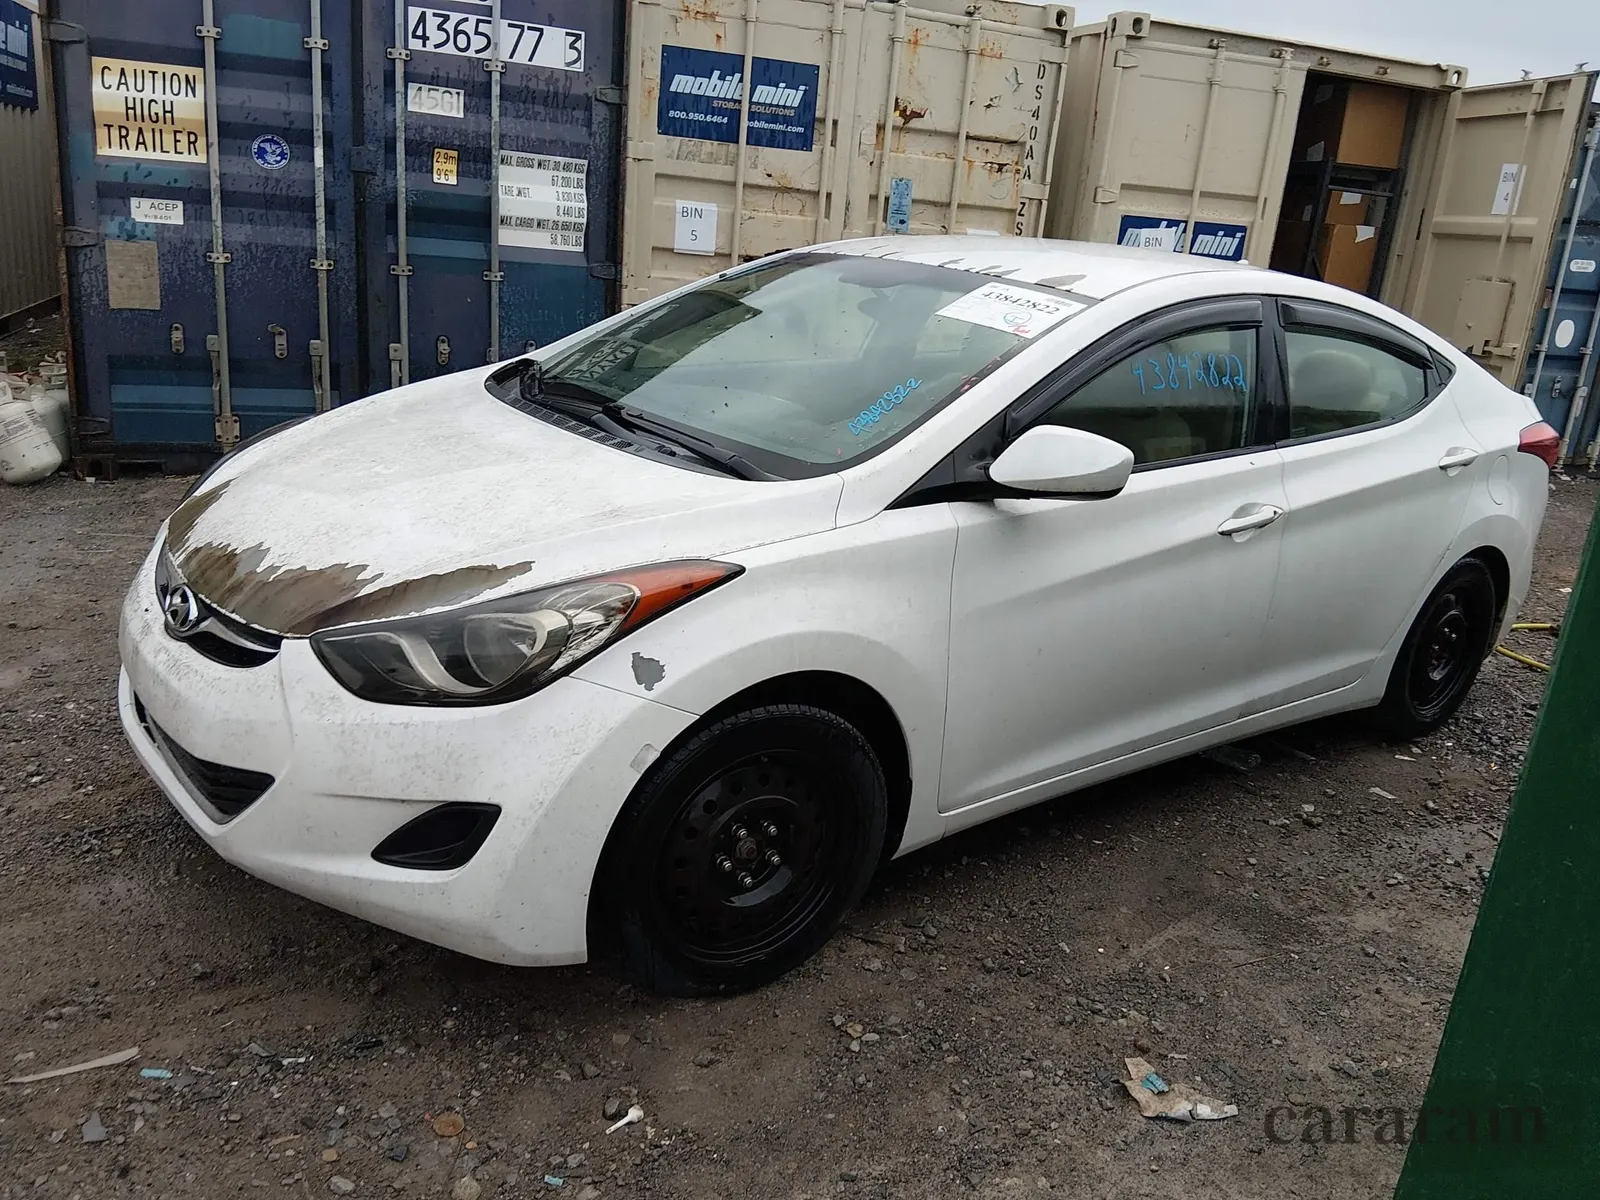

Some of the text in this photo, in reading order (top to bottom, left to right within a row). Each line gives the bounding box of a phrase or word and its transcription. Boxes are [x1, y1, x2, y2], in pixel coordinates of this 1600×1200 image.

[411, 10, 492, 54] 4365
[564, 31, 582, 68] 3
[100, 65, 197, 98] CAUTION
[751, 82, 804, 108] mini
[124, 96, 175, 126] HIGH
[668, 109, 728, 125] 800.950.6464
[712, 100, 796, 117] STORA SOLUTIONS
[746, 119, 805, 134] obilemini.com
[103, 123, 199, 156] TRAILER
[500, 154, 515, 166] MAX.
[515, 156, 536, 169] GROSS
[573, 163, 586, 174] KGS
[500, 184, 515, 197] TARE
[572, 176, 584, 189] LBS
[149, 202, 179, 212] ACEP
[574, 206, 585, 219] LBS
[681, 205, 703, 220] BIN
[500, 215, 514, 227] MAX.
[514, 216, 534, 229] CARGO
[572, 221, 585, 232] KGS
[571, 235, 583, 247] LBS
[690, 229, 698, 242] 5
[1144, 236, 1163, 249] BIN
[1191, 230, 1243, 257] mini
[981, 291, 1061, 315] 43842822
[1130, 351, 1248, 395] 43842822
